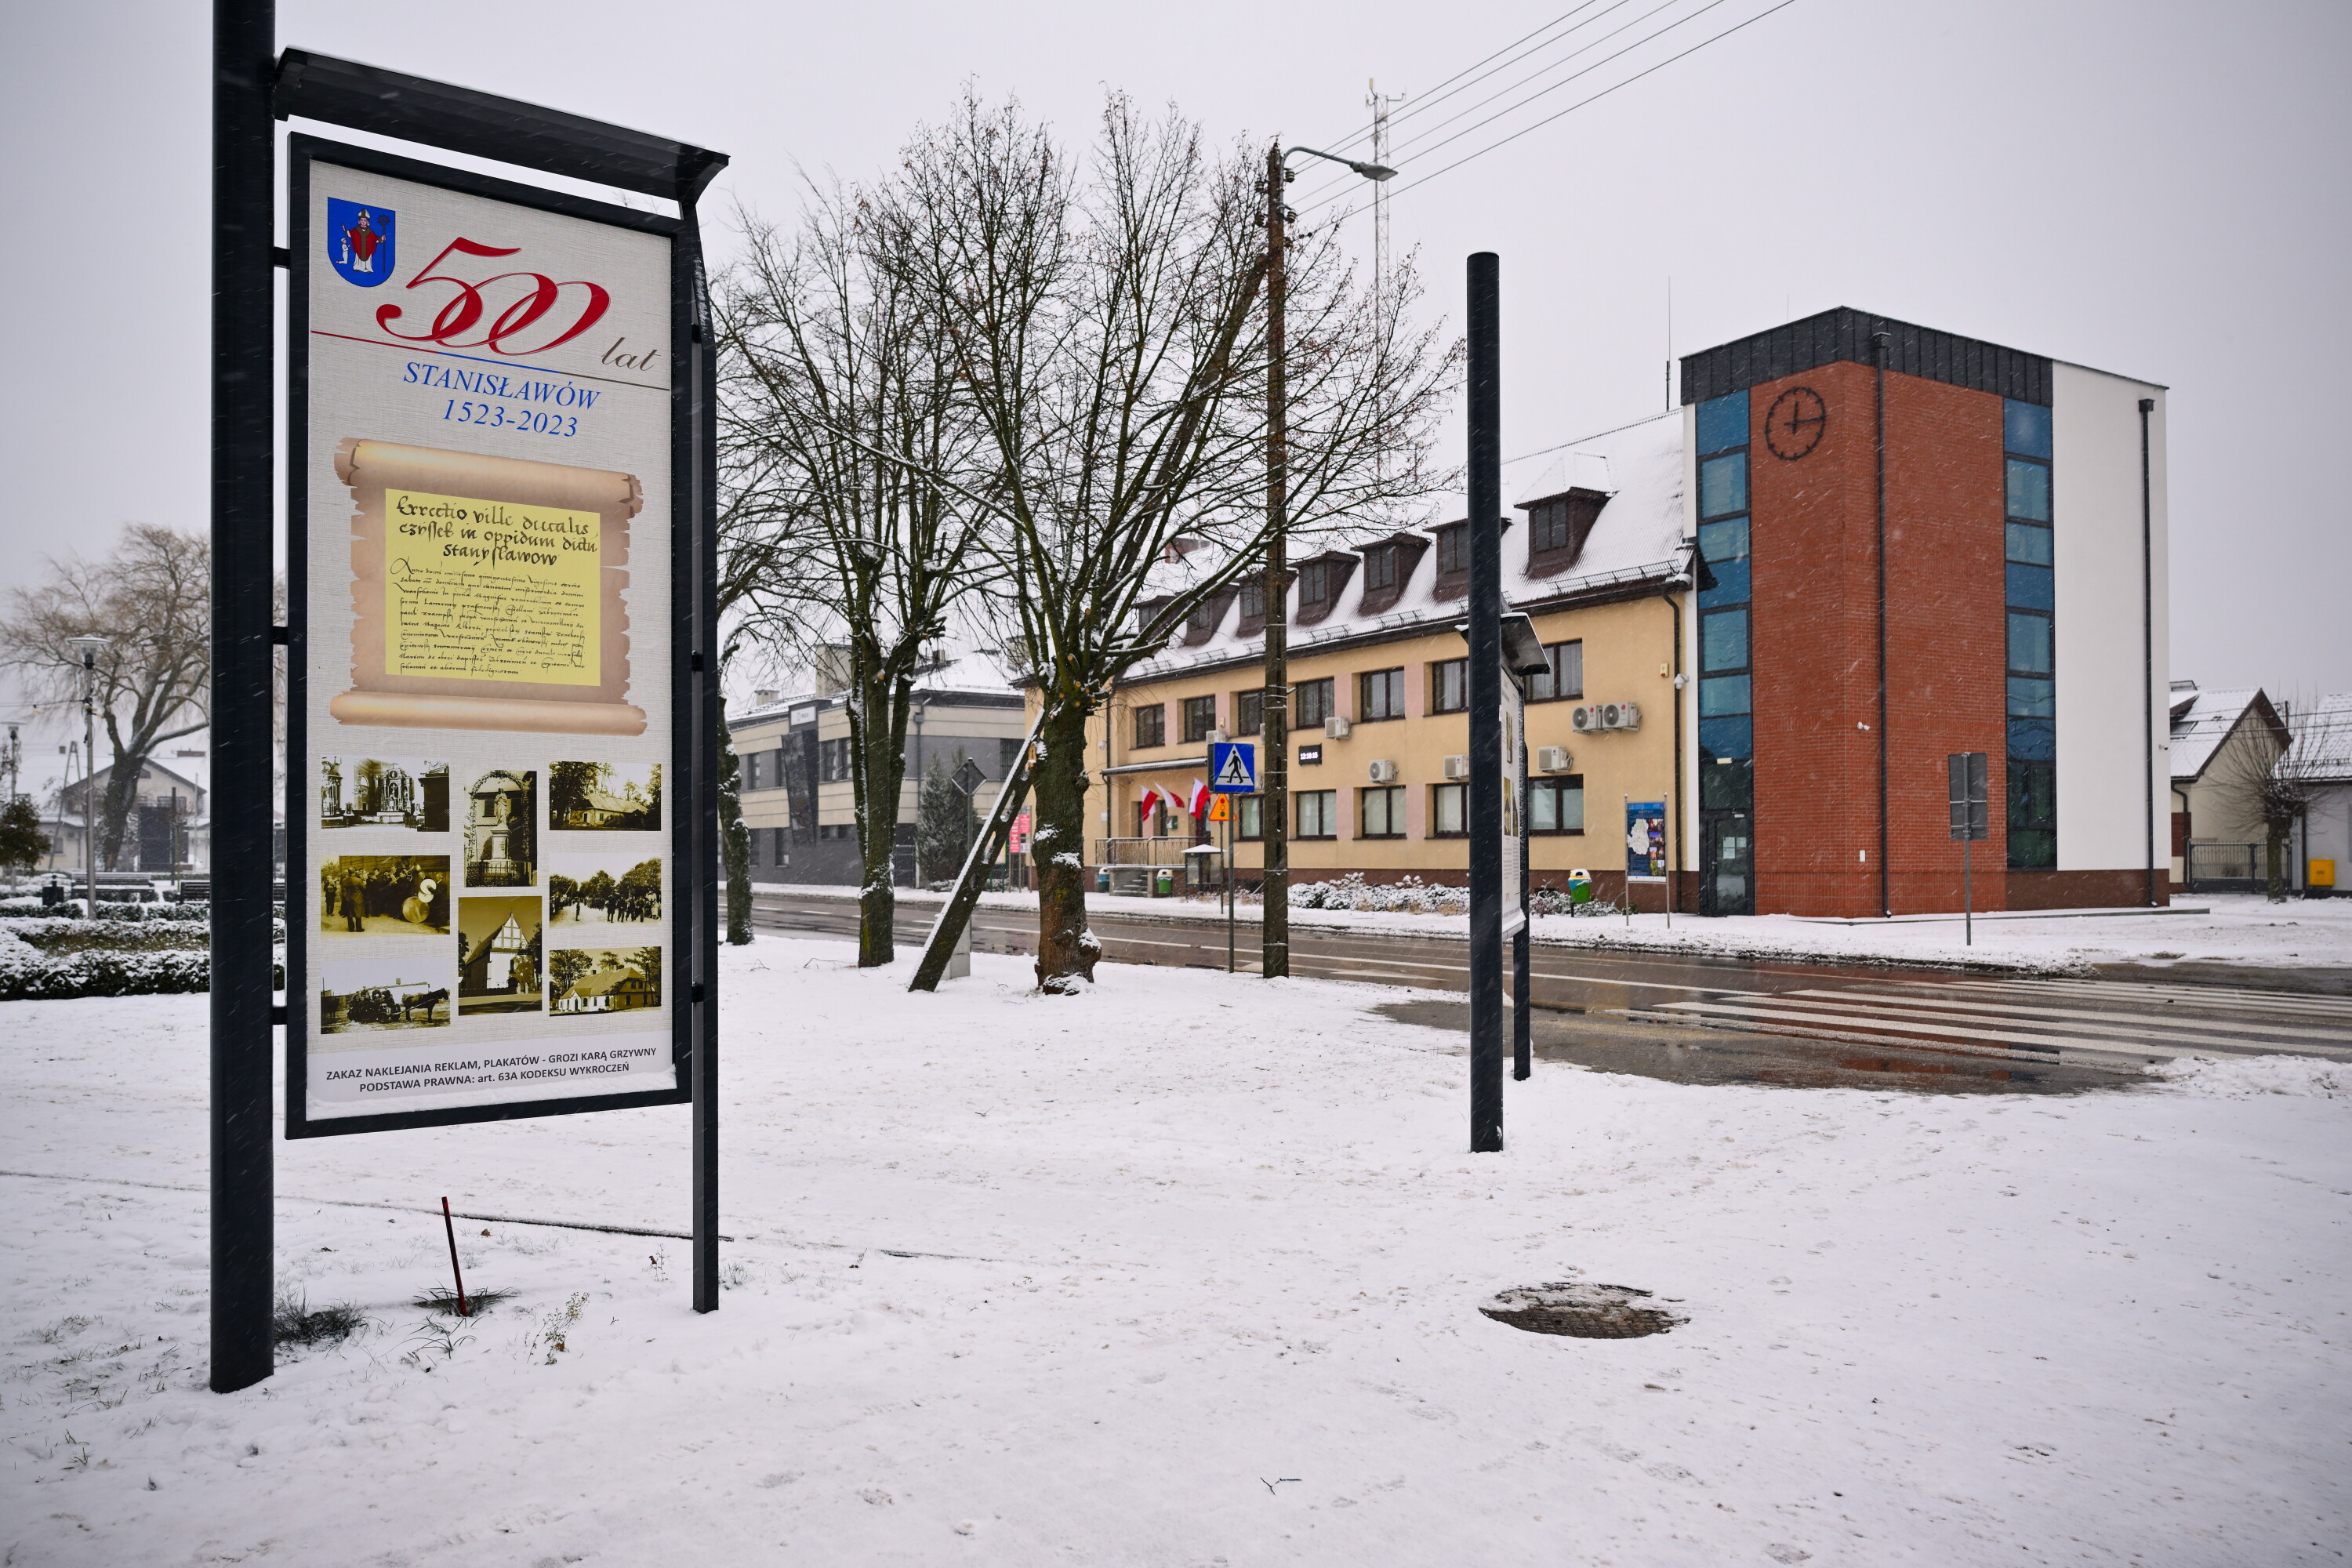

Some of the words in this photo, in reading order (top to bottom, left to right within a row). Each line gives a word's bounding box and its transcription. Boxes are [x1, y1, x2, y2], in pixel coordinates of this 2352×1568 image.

[376, 237, 611, 355] 500
[601, 336, 662, 372] lat
[403, 361, 601, 410] STANISŁAWÓW
[442, 399, 578, 437] 1523-2023
[326, 1069, 362, 1080] ZAKAZ
[365, 1064, 431, 1077] NAKLEJANIA
[434, 1061, 481, 1072] REKLAM,
[484, 1055, 539, 1068] PLAKATÓW
[548, 1053, 579, 1063] GROZI
[582, 1051, 608, 1062] KARĄ
[610, 1048, 657, 1058] GRZYWNY
[360, 1080, 421, 1092] PODSTAWA
[424, 1075, 475, 1087] PRAWNA:
[477, 1073, 495, 1083] art.
[498, 1071, 517, 1081] 63A
[521, 1068, 567, 1080] KODEKSU
[569, 1062, 630, 1076] WYKROCZEŃ
